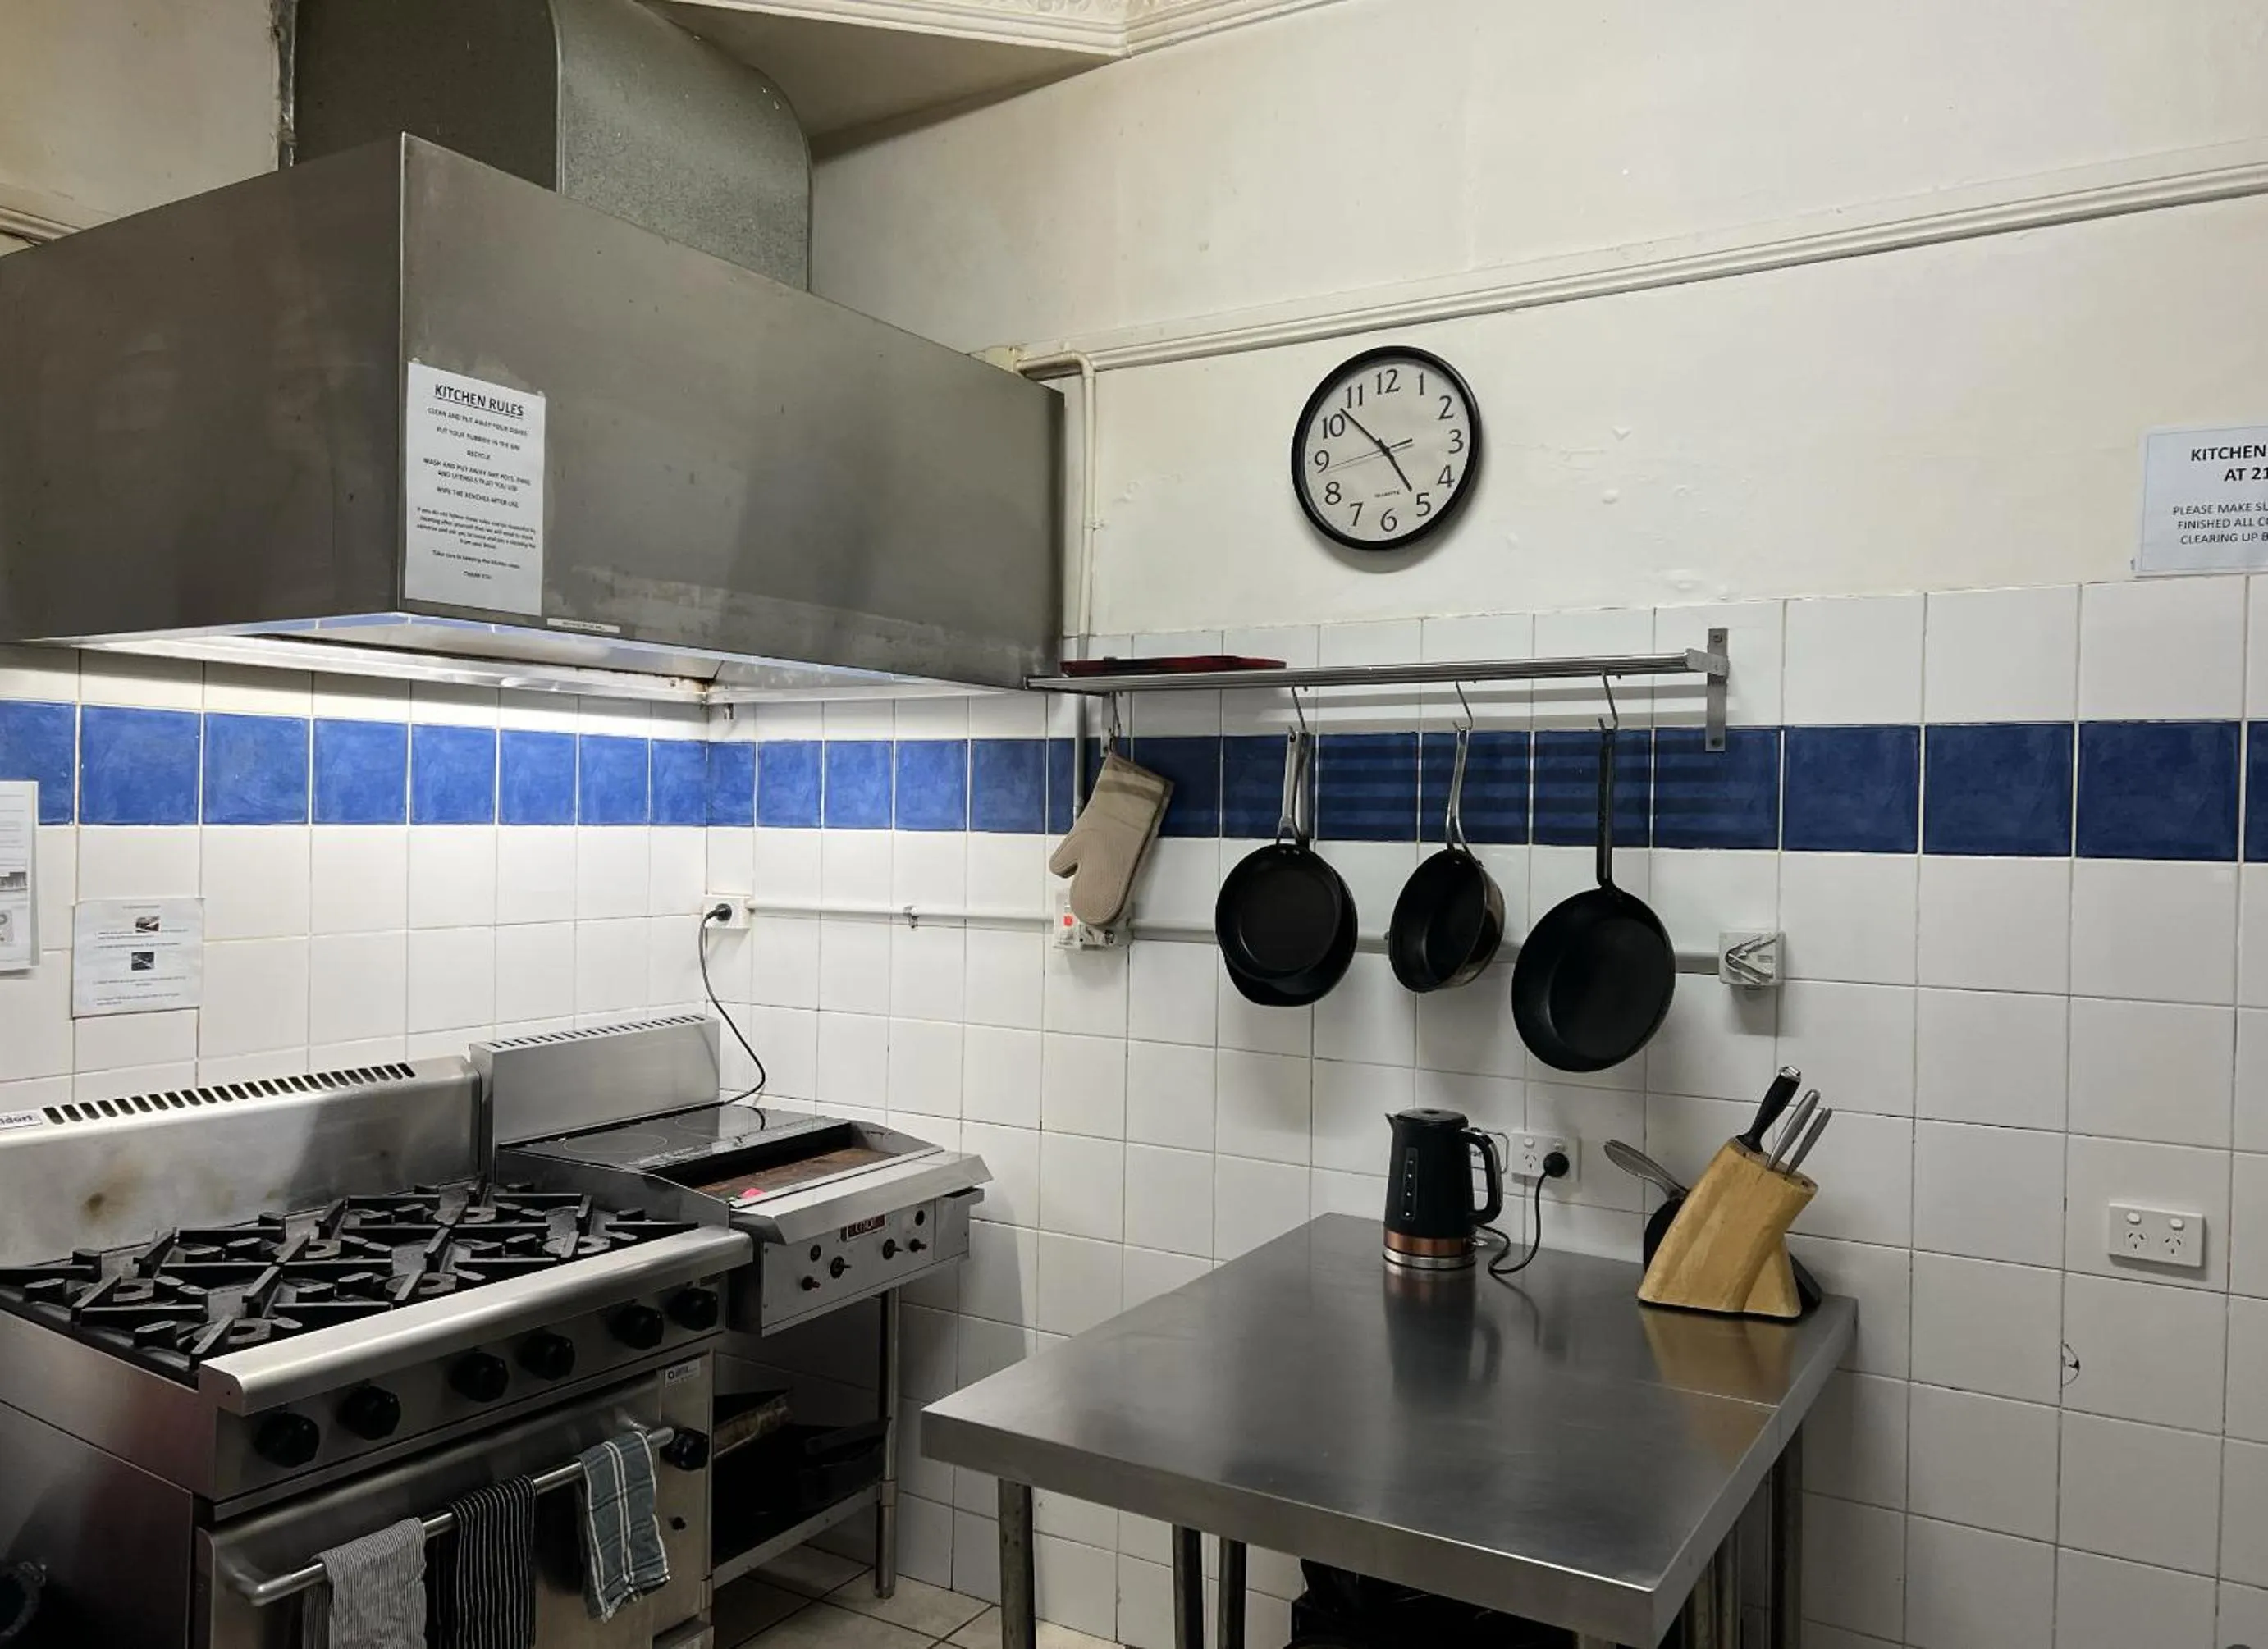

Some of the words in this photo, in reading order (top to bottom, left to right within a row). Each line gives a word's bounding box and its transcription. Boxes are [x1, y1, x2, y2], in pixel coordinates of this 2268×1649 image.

[1376, 368, 1401, 395] 12
[1418, 372, 1424, 395] 1
[435, 384, 486, 407] KITCHEN
[489, 398, 524, 417] RULES
[1346, 383, 1363, 409] 11
[1438, 395, 1454, 420] 2
[1322, 413, 1345, 439] 10
[1448, 429, 1463, 454] 3
[2191, 444, 2266, 461] KITCHEN
[1315, 450, 1330, 473] 9
[1437, 464, 1455, 488] 4
[2224, 468, 2247, 482] AT
[1324, 481, 1342, 505] 8
[1415, 492, 1431, 517] 5
[1349, 501, 1364, 527] 7
[1380, 507, 1397, 532] 6
[2172, 504, 2214, 515] PLEASE
[2217, 502, 2252, 513] MAKE
[2177, 518, 2231, 529] FINISHED
[2234, 518, 2255, 527] ALL
[2180, 533, 2238, 545] CLEARING
[2242, 532, 2258, 542] UP
